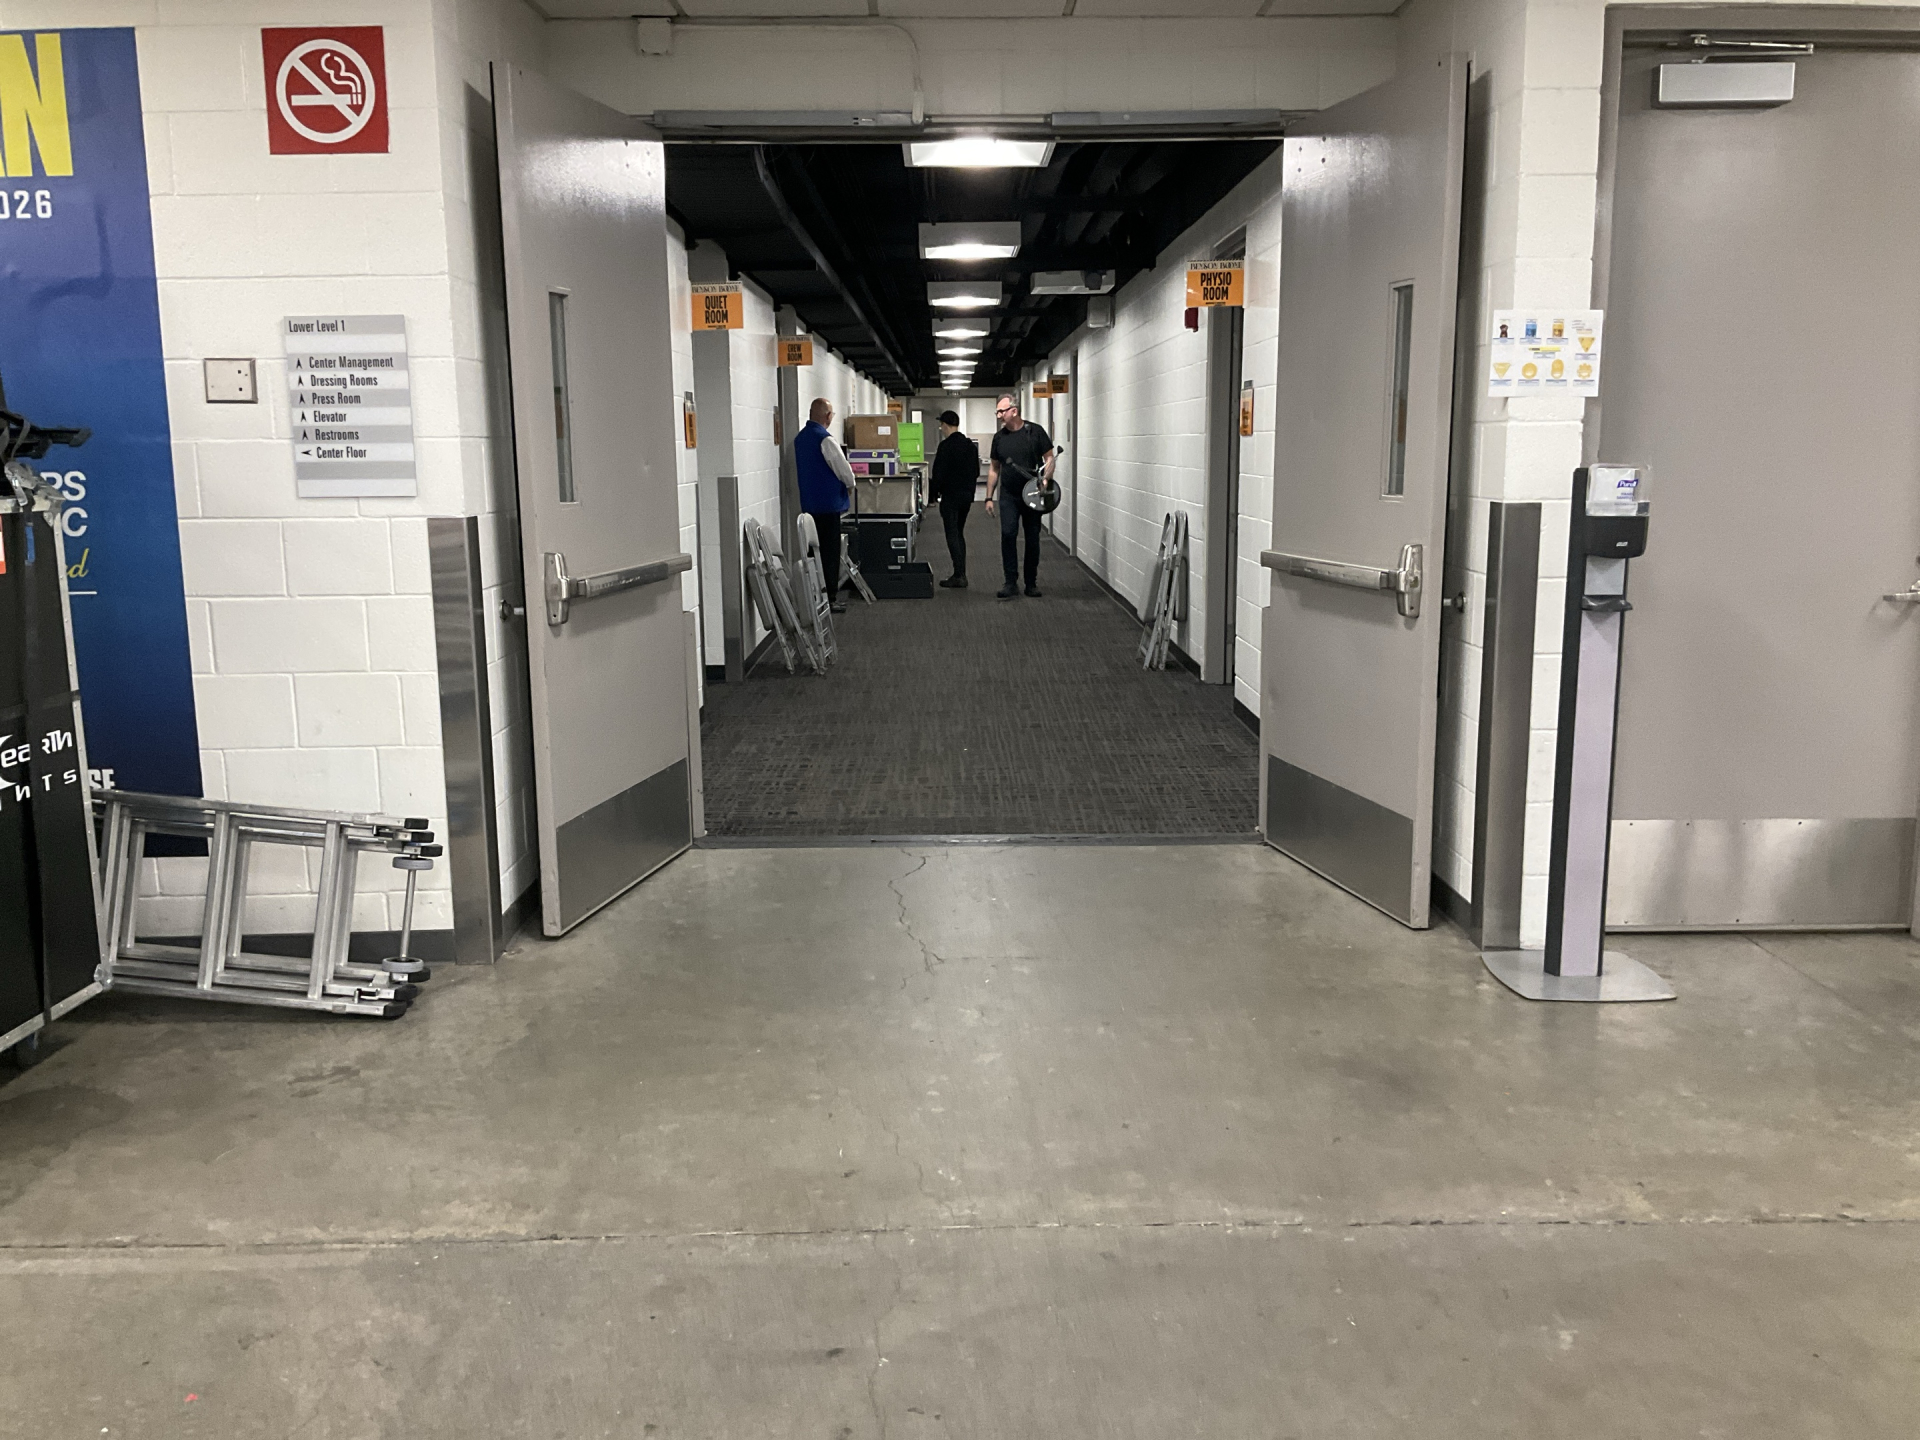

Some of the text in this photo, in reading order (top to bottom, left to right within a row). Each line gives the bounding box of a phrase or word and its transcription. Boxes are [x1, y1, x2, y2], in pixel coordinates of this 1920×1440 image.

[1200, 272, 1232, 286] PHYSIO
[1203, 286, 1229, 301] ROOM
[705, 295, 727, 310] QUIET
[705, 310, 728, 324] ROOM
[288, 319, 346, 333] Lower Level 1
[309, 356, 394, 370] Center Management
[310, 373, 378, 389] Dressing Rooms
[312, 392, 361, 404] Press Room
[313, 411, 347, 422] Elevator
[315, 429, 359, 440] Restrooms
[316, 446, 367, 459] Center Floor
